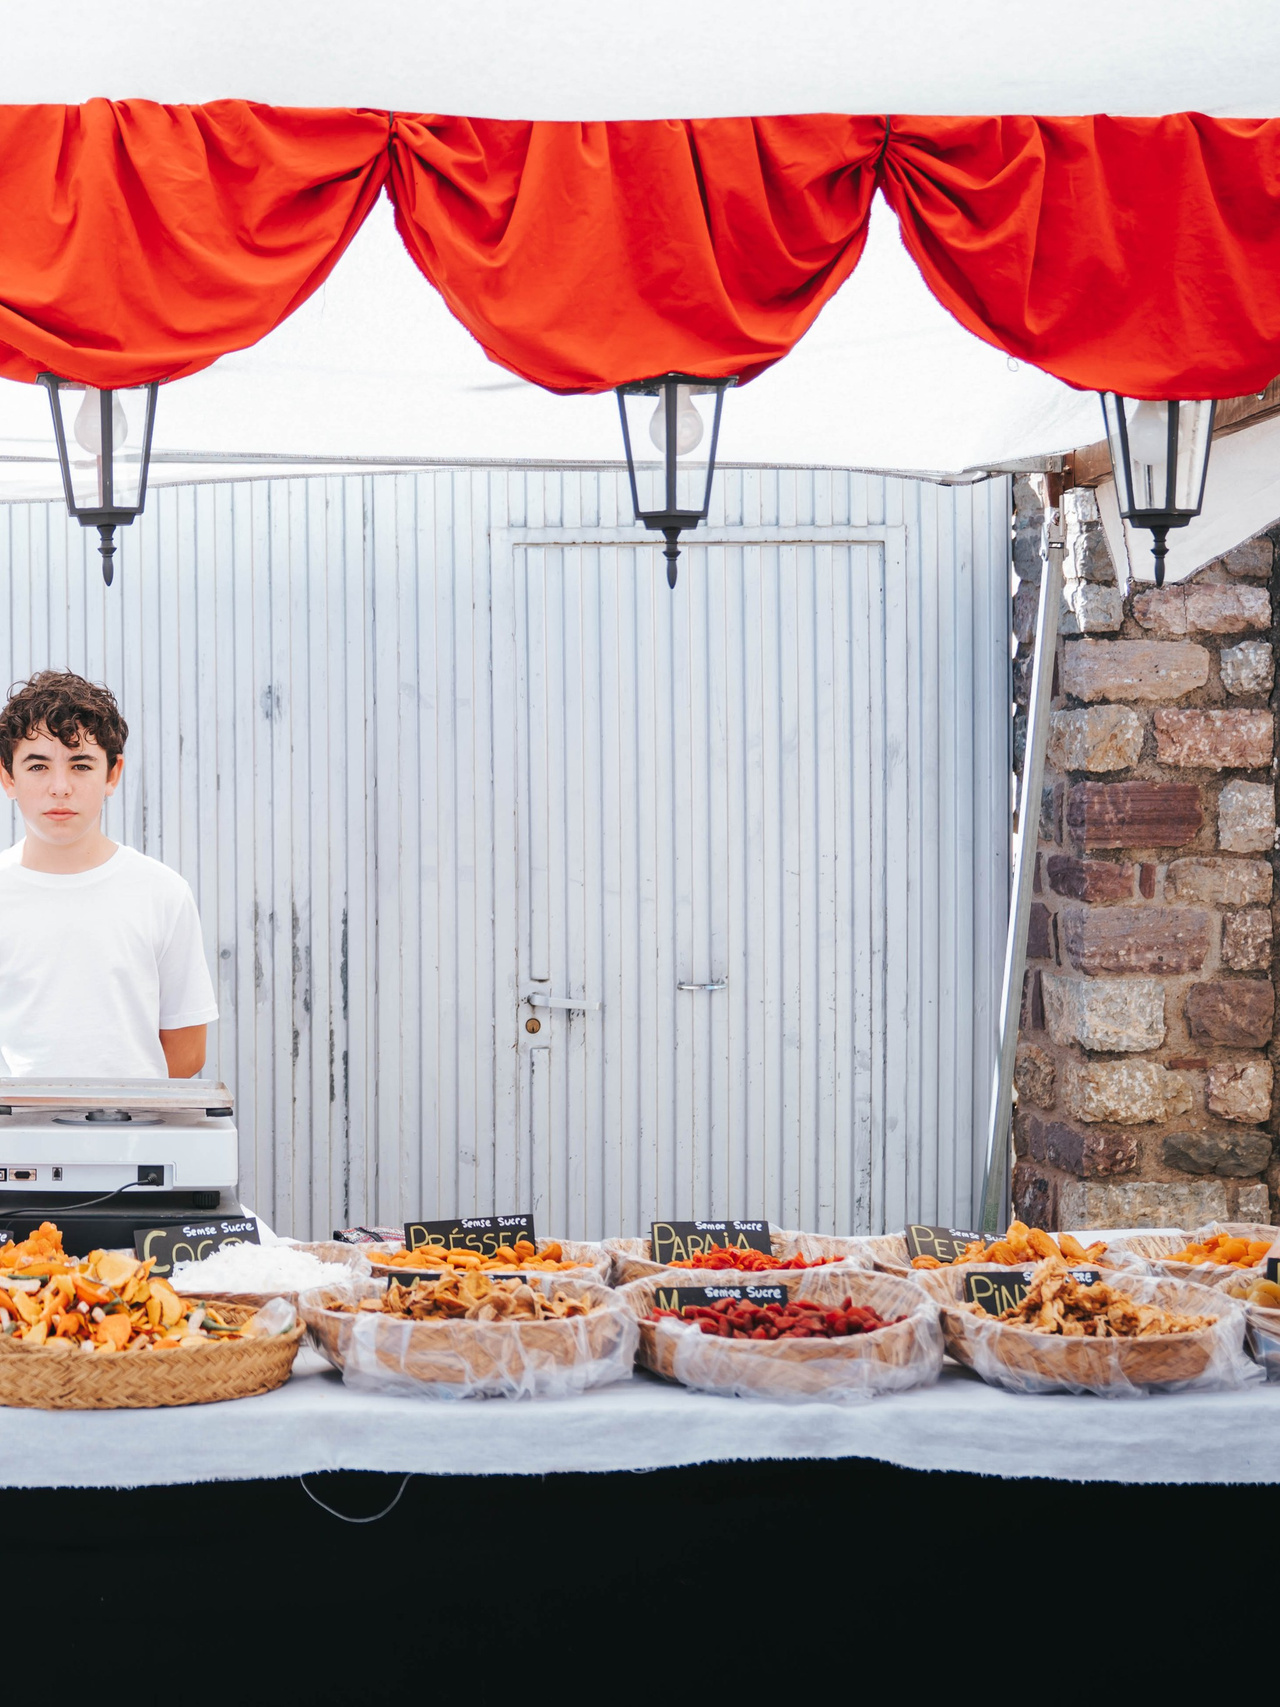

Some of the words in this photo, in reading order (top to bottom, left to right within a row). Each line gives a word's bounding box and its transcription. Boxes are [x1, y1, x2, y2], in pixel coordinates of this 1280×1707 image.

[220, 1222, 255, 1233] Sucre
[497, 1217, 527, 1227] Sucre
[733, 1221, 763, 1232] Sucre
[746, 1286, 783, 1299] Sucre
